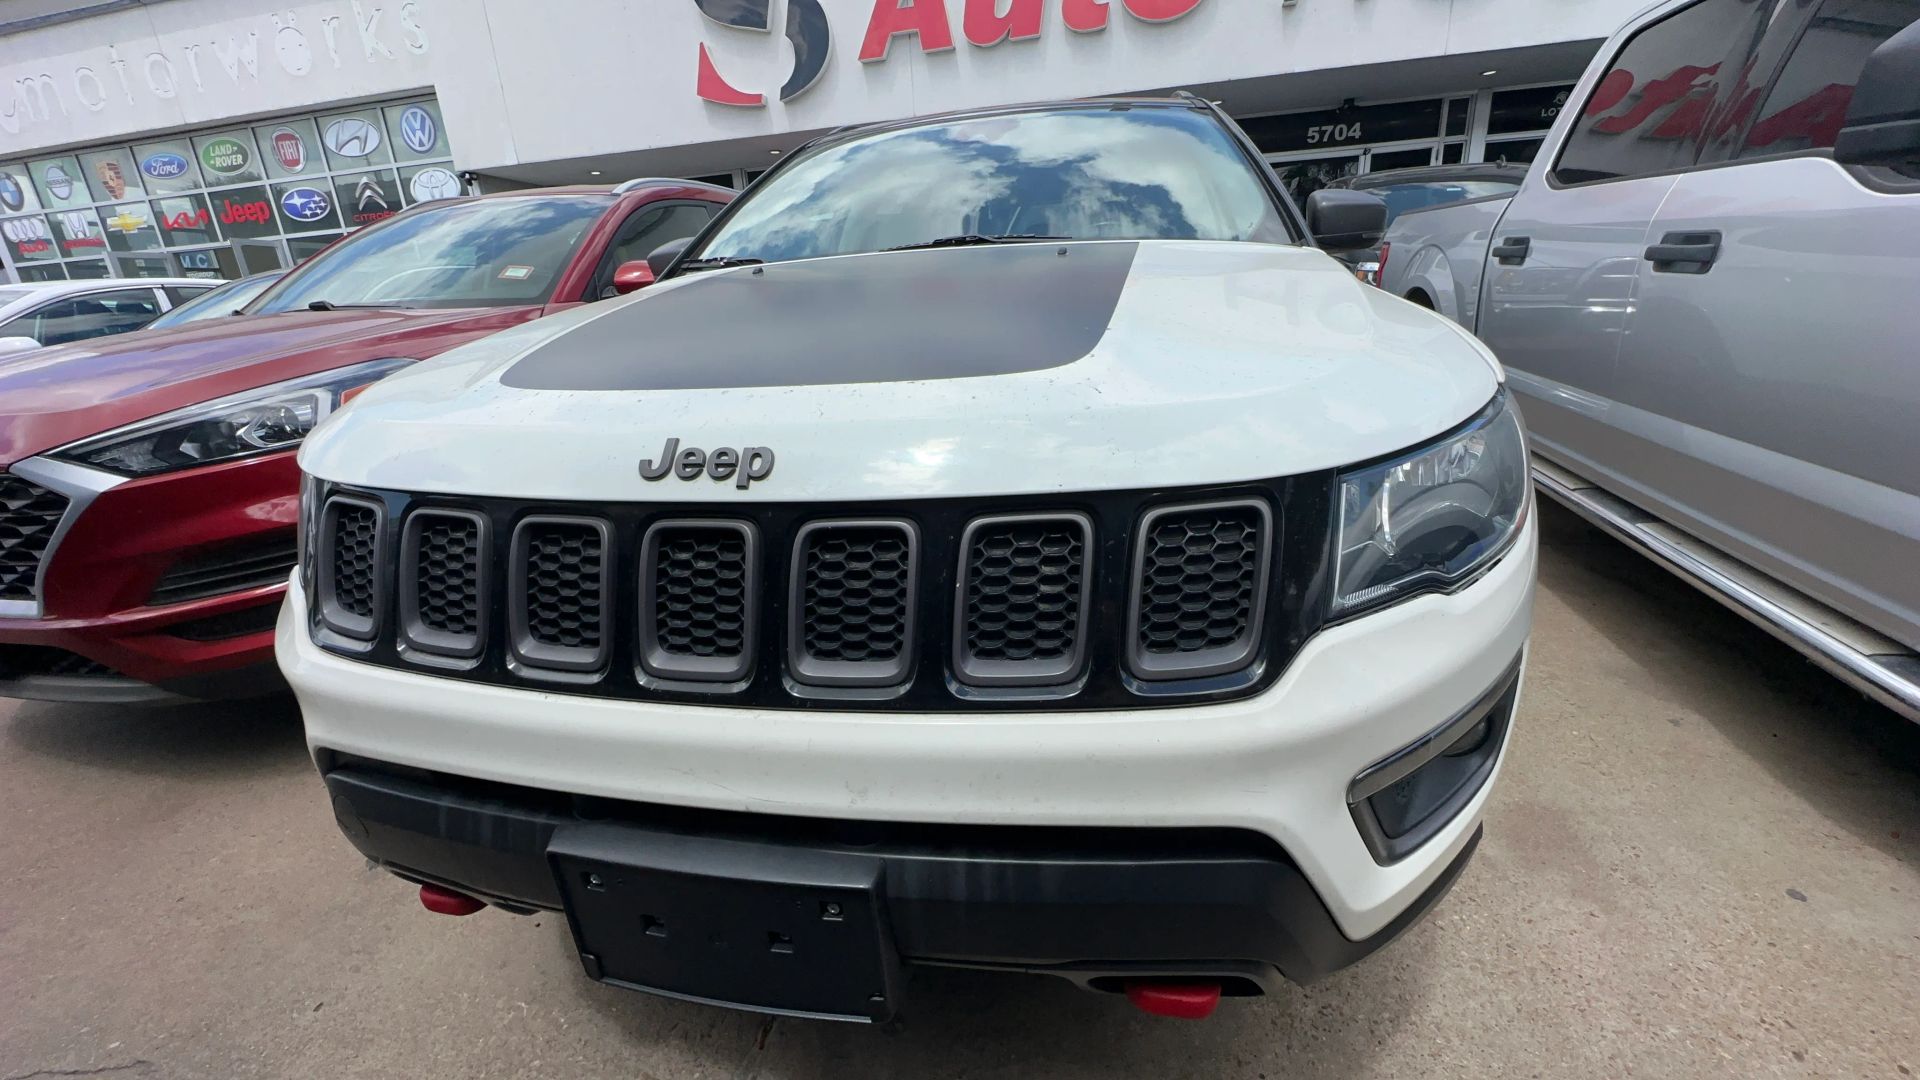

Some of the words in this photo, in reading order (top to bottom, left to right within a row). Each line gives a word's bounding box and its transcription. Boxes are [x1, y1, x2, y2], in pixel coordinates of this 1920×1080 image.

[1306, 122, 1362, 144] 5704
[209, 143, 233, 157] LAND
[214, 153, 243, 168] ROVER
[277, 139, 300, 161] FIAT
[151, 157, 180, 176] Ford
[220, 199, 271, 225] Jeep
[638, 437, 776, 491] Jeep
